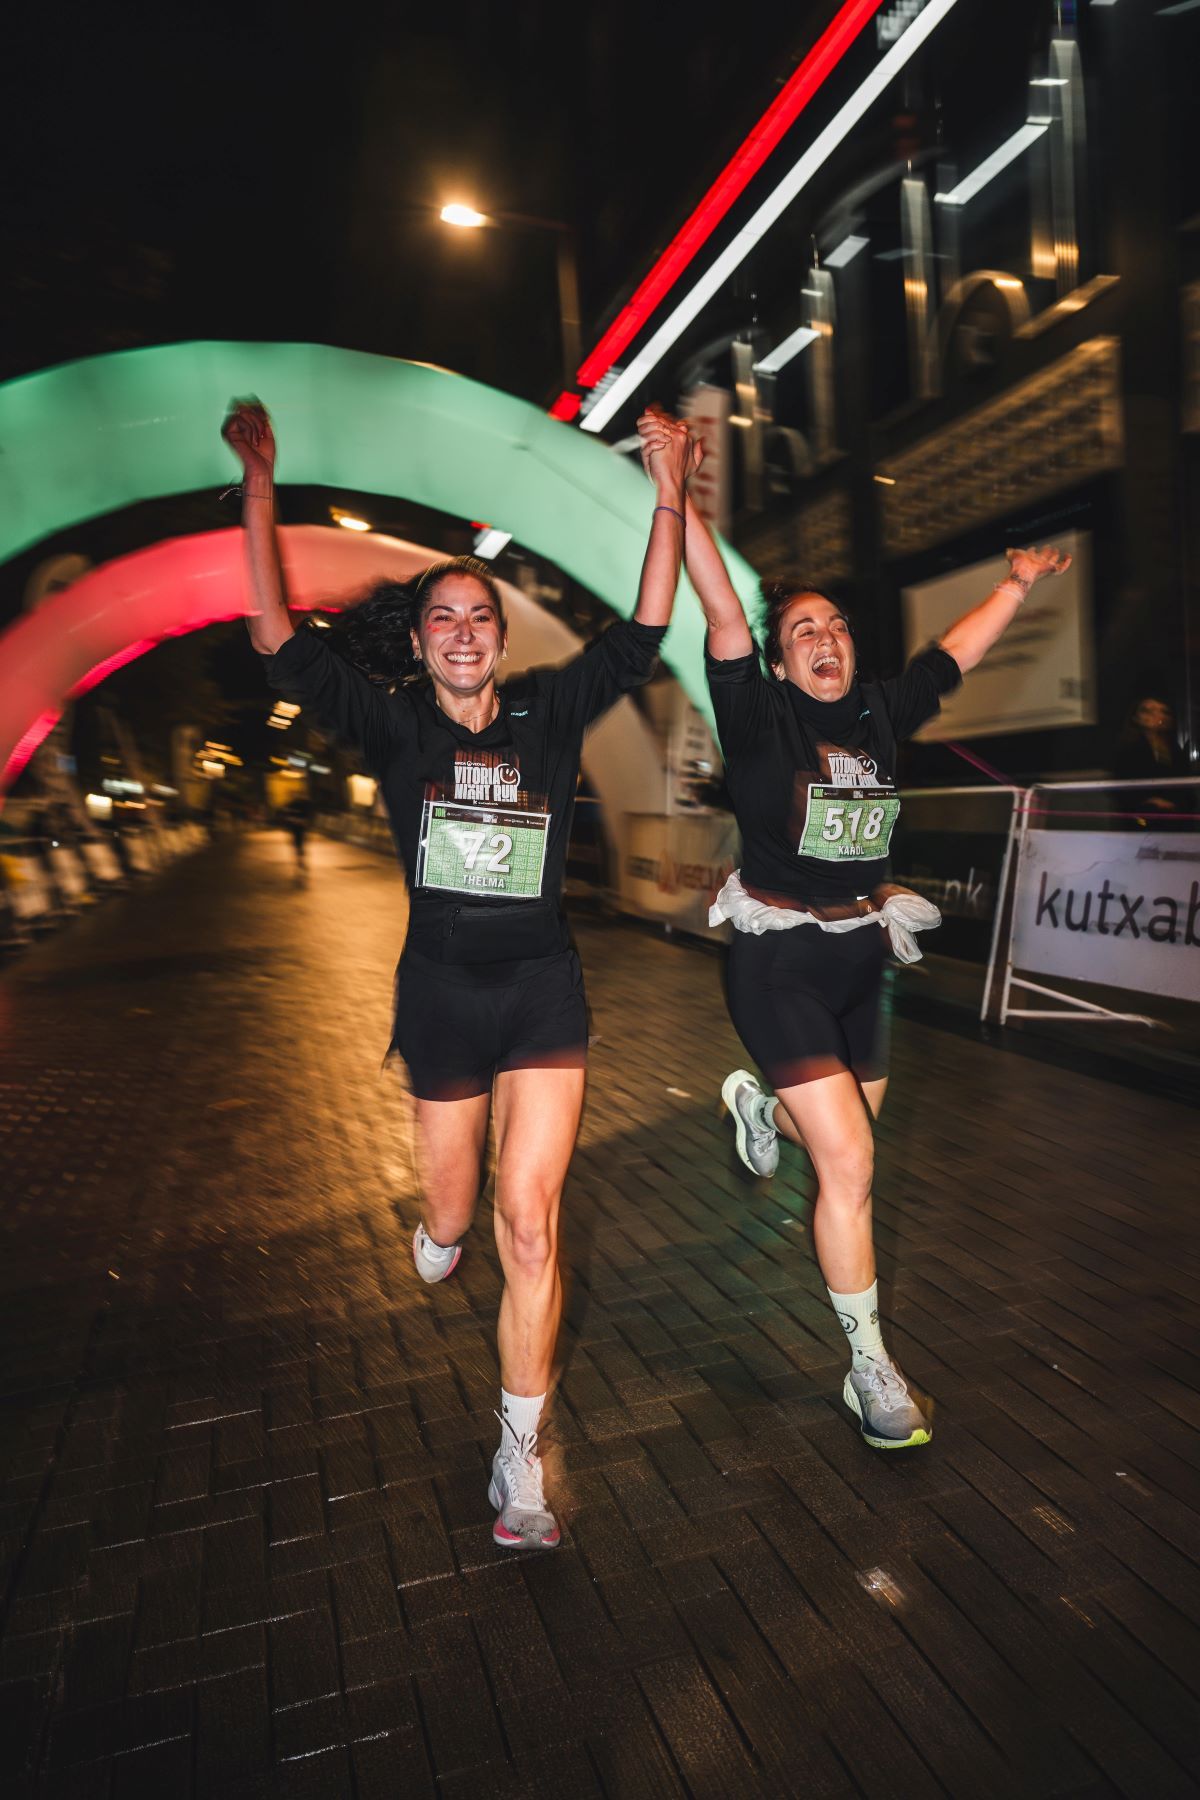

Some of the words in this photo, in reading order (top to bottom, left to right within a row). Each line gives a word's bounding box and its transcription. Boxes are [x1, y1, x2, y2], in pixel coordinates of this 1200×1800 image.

[454, 766, 501, 785] VITORIA
[828, 757, 864, 775] VITORIA
[454, 784, 490, 801] NIGHT
[493, 784, 518, 803] RUN
[822, 807, 885, 841] 518
[461, 831, 513, 873] 72
[838, 845, 865, 856] KAROL
[462, 874, 505, 889] THELMA
